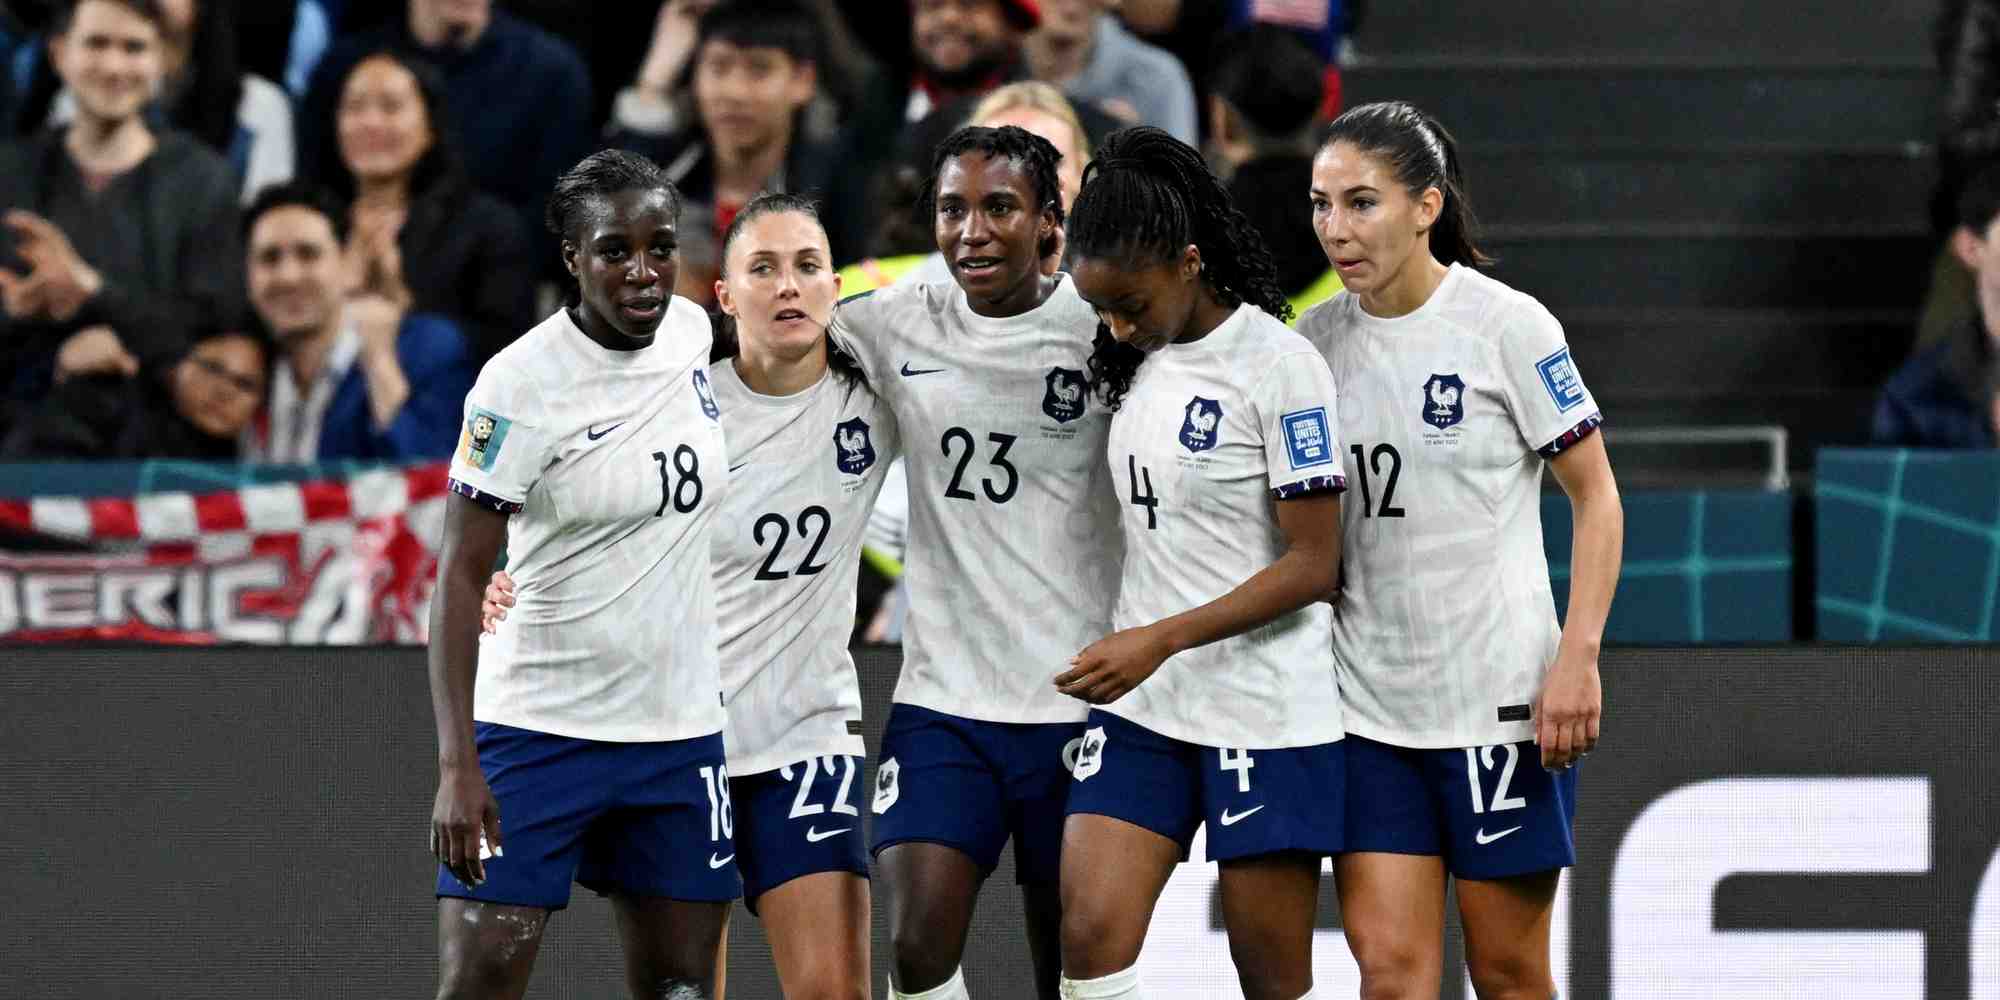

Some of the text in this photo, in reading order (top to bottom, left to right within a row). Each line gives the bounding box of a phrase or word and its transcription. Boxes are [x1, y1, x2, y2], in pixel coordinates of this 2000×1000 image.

[652, 443, 703, 517] 18
[941, 427, 1019, 504] 23
[1129, 454, 1159, 529] 4
[1350, 443, 1406, 518] 12
[753, 505, 832, 580] 22
[699, 765, 733, 841] 18
[780, 755, 859, 819] 22
[1219, 748, 1255, 792] 4
[1466, 744, 1526, 814] 12
